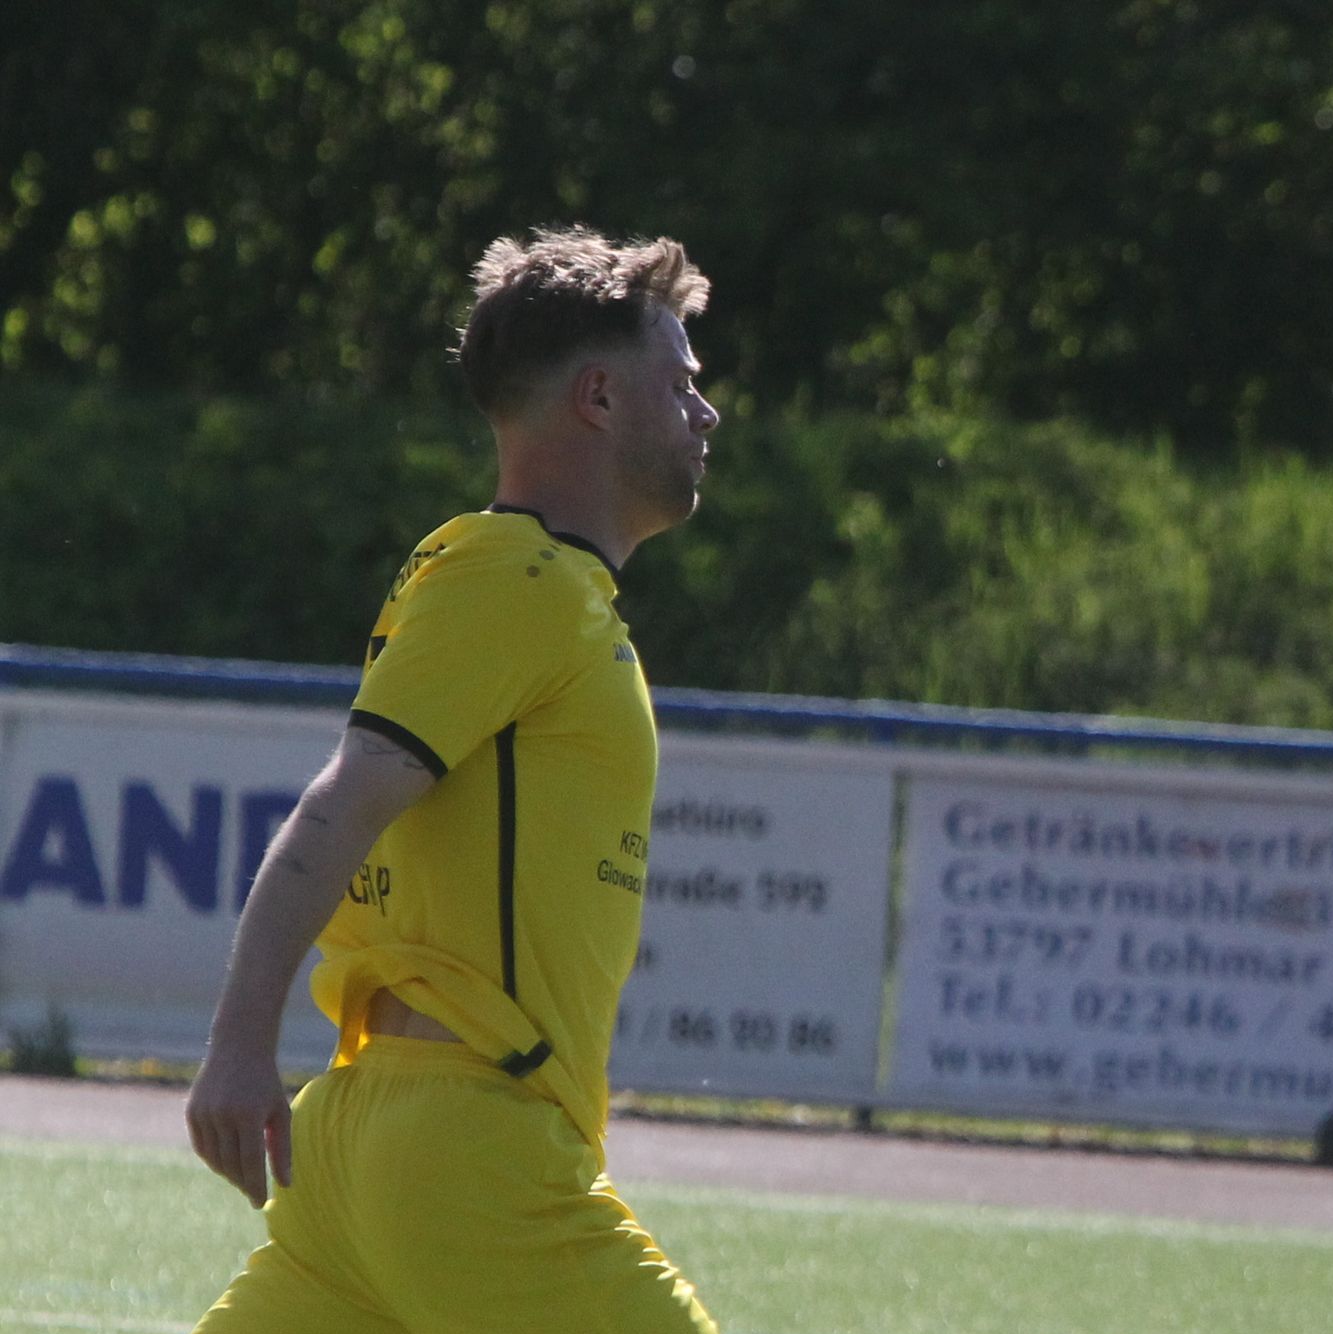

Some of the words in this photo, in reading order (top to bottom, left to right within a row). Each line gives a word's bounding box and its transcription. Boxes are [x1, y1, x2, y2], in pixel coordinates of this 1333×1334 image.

[620, 830, 641, 858] KFZ
[597, 859, 642, 896] Glowac
[937, 914, 1093, 970] 53797
[1117, 930, 1326, 986] Lohmar
[1071, 982, 1244, 1038] 02246
